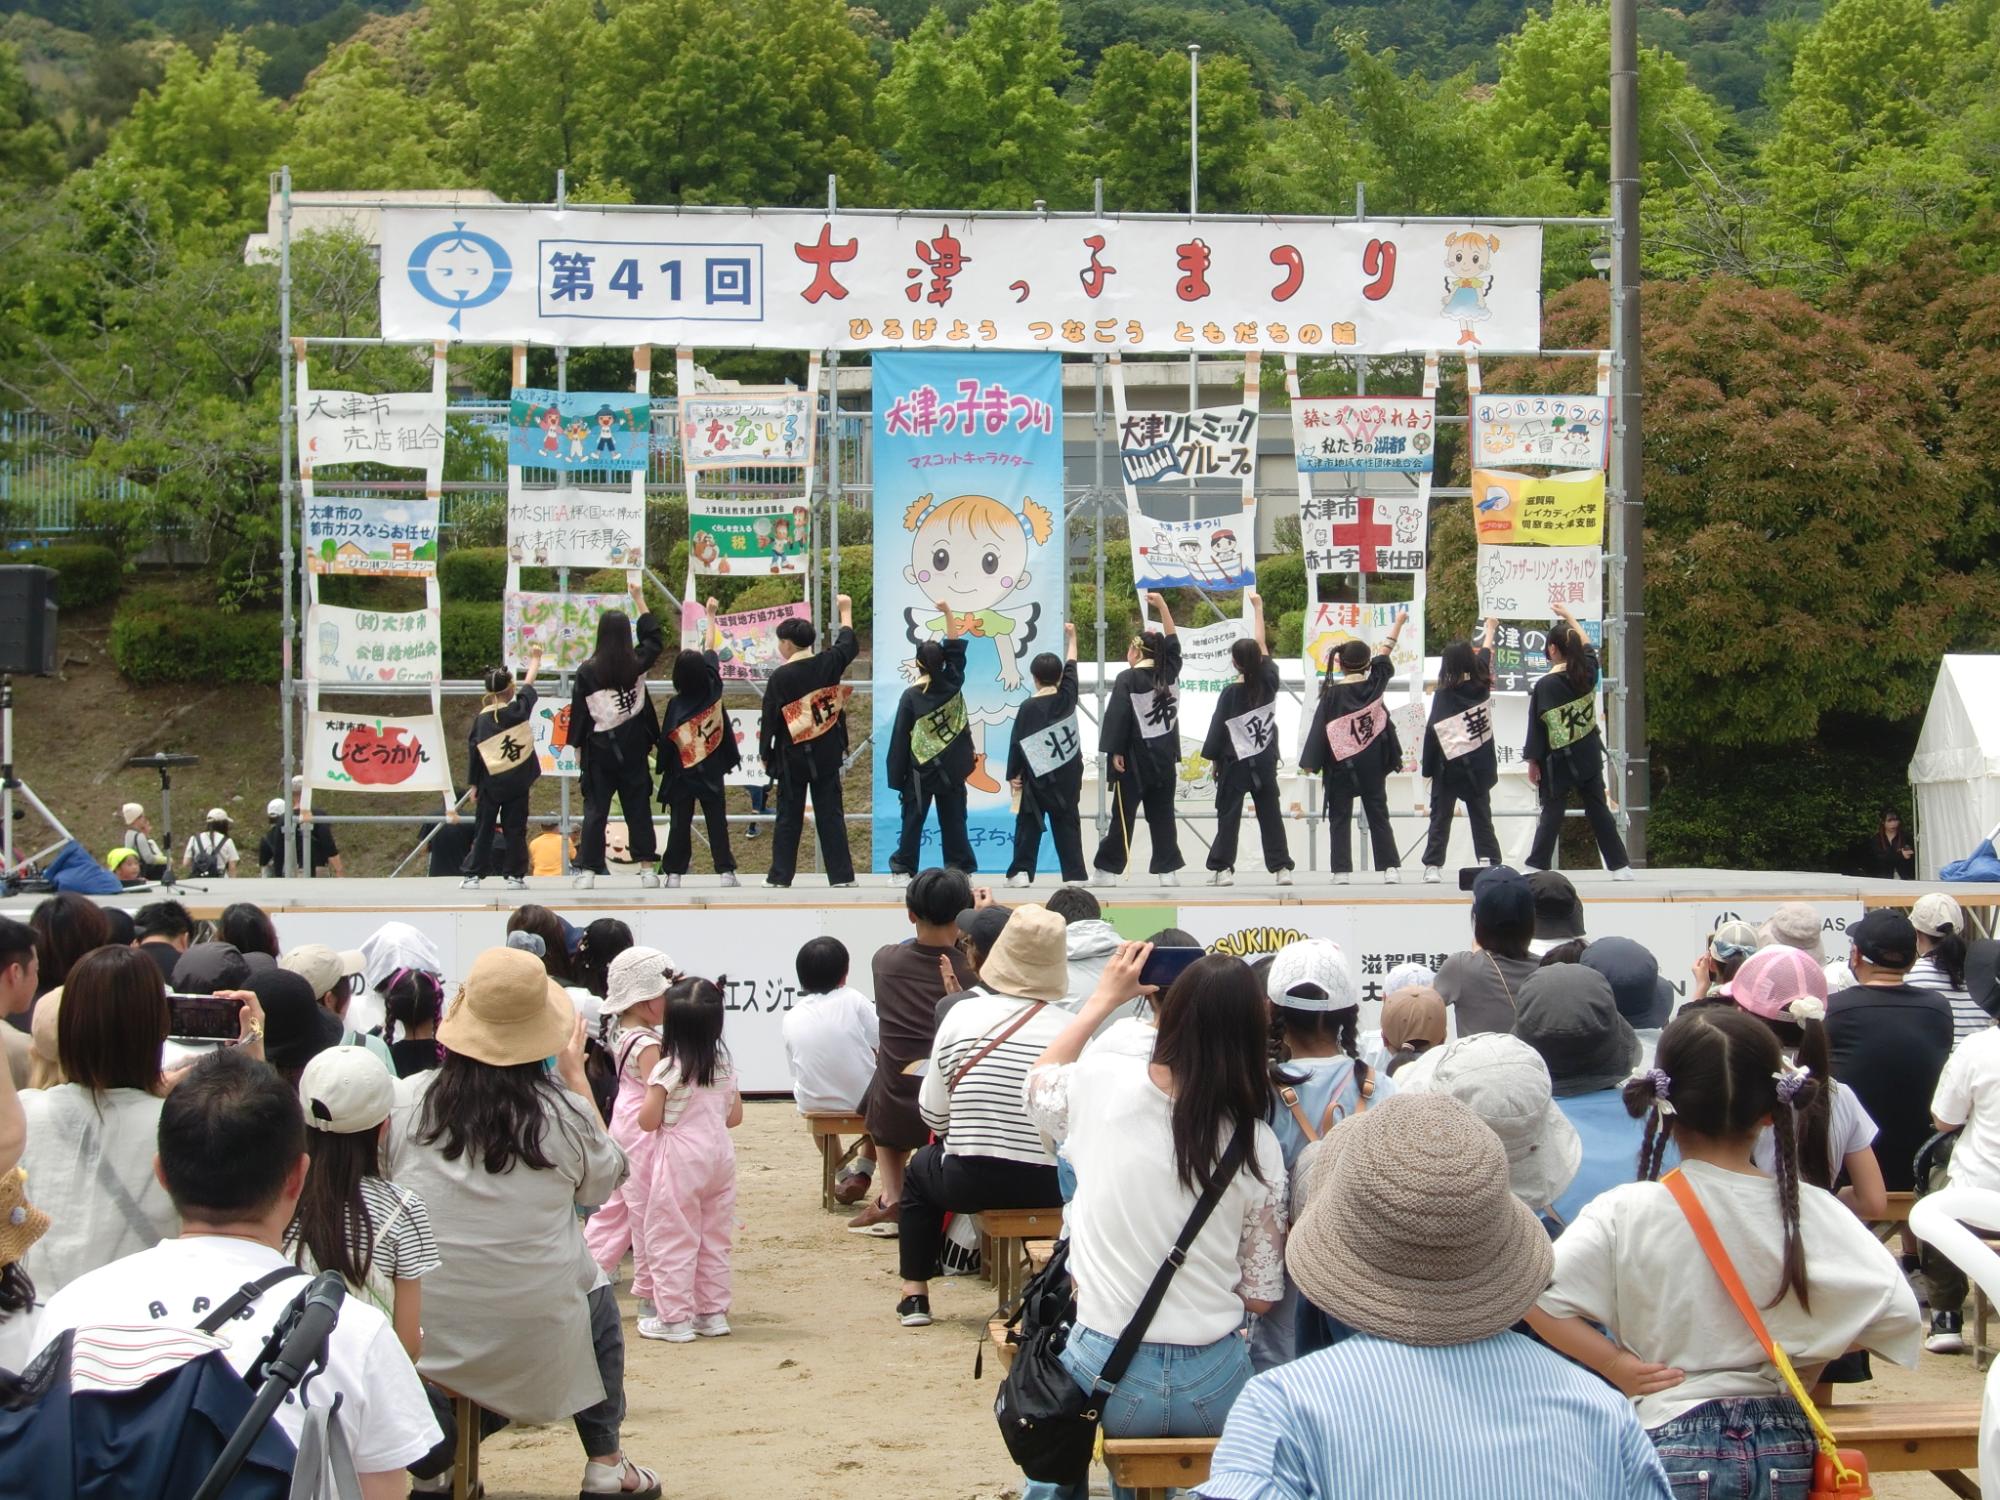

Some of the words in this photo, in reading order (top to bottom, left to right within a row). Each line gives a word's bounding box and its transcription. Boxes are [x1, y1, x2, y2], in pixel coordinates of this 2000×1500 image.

[548, 250, 752, 306] 第41回
[794, 222, 1397, 308] 大津っ子まつり
[849, 318, 998, 343] ひろげよう
[1028, 319, 1145, 344] つなごう
[1175, 320, 1357, 345] ともだちの輪
[305, 394, 390, 425] 大津市
[886, 379, 1053, 436] 大津っ子まつり
[1480, 400, 1601, 424] ガールスカウト
[343, 423, 445, 453] 売店組合
[705, 414, 799, 451] なないろ
[1120, 408, 1258, 451] 大津リトミック
[1321, 435, 1407, 455] 私たちの湖都
[907, 451, 1035, 469] マスコットキャラクター
[1176, 439, 1253, 475] グループ
[1306, 457, 1424, 469] 大津市地域女性団体連合会
[1301, 496, 1359, 521] 大津市
[1523, 504, 1597, 518] レイカディア大学
[1525, 495, 1555, 505] 滋賀県
[309, 504, 363, 520] 大津市の
[1521, 517, 1596, 530] 同窓会大津支部
[310, 522, 437, 540] 都市ガスならお任せ!
[1158, 518, 1222, 533] 大津っ子まつり
[731, 535, 747, 550] 税
[1305, 548, 1359, 570] 赤十字
[1376, 549, 1424, 570] 奉仕団
[1505, 557, 1596, 581] ファザーリング・ジャパン
[1486, 597, 1518, 611] FJSG
[1547, 581, 1585, 604] 滋賀
[715, 606, 795, 627] 滋賀地方協力本部
[1192, 631, 1237, 647] 地域の子どもは
[346, 664, 374, 681] We
[326, 719, 367, 733] 大津市立
[927, 707, 957, 744] 音
[1244, 711, 1276, 749] 彩
[1349, 713, 1375, 746] 優
[1463, 707, 1490, 745] 華
[1560, 701, 1594, 741] 知
[332, 742, 431, 765] じどうかん
[500, 734, 526, 763] 香
[1044, 725, 1078, 761] 壮
